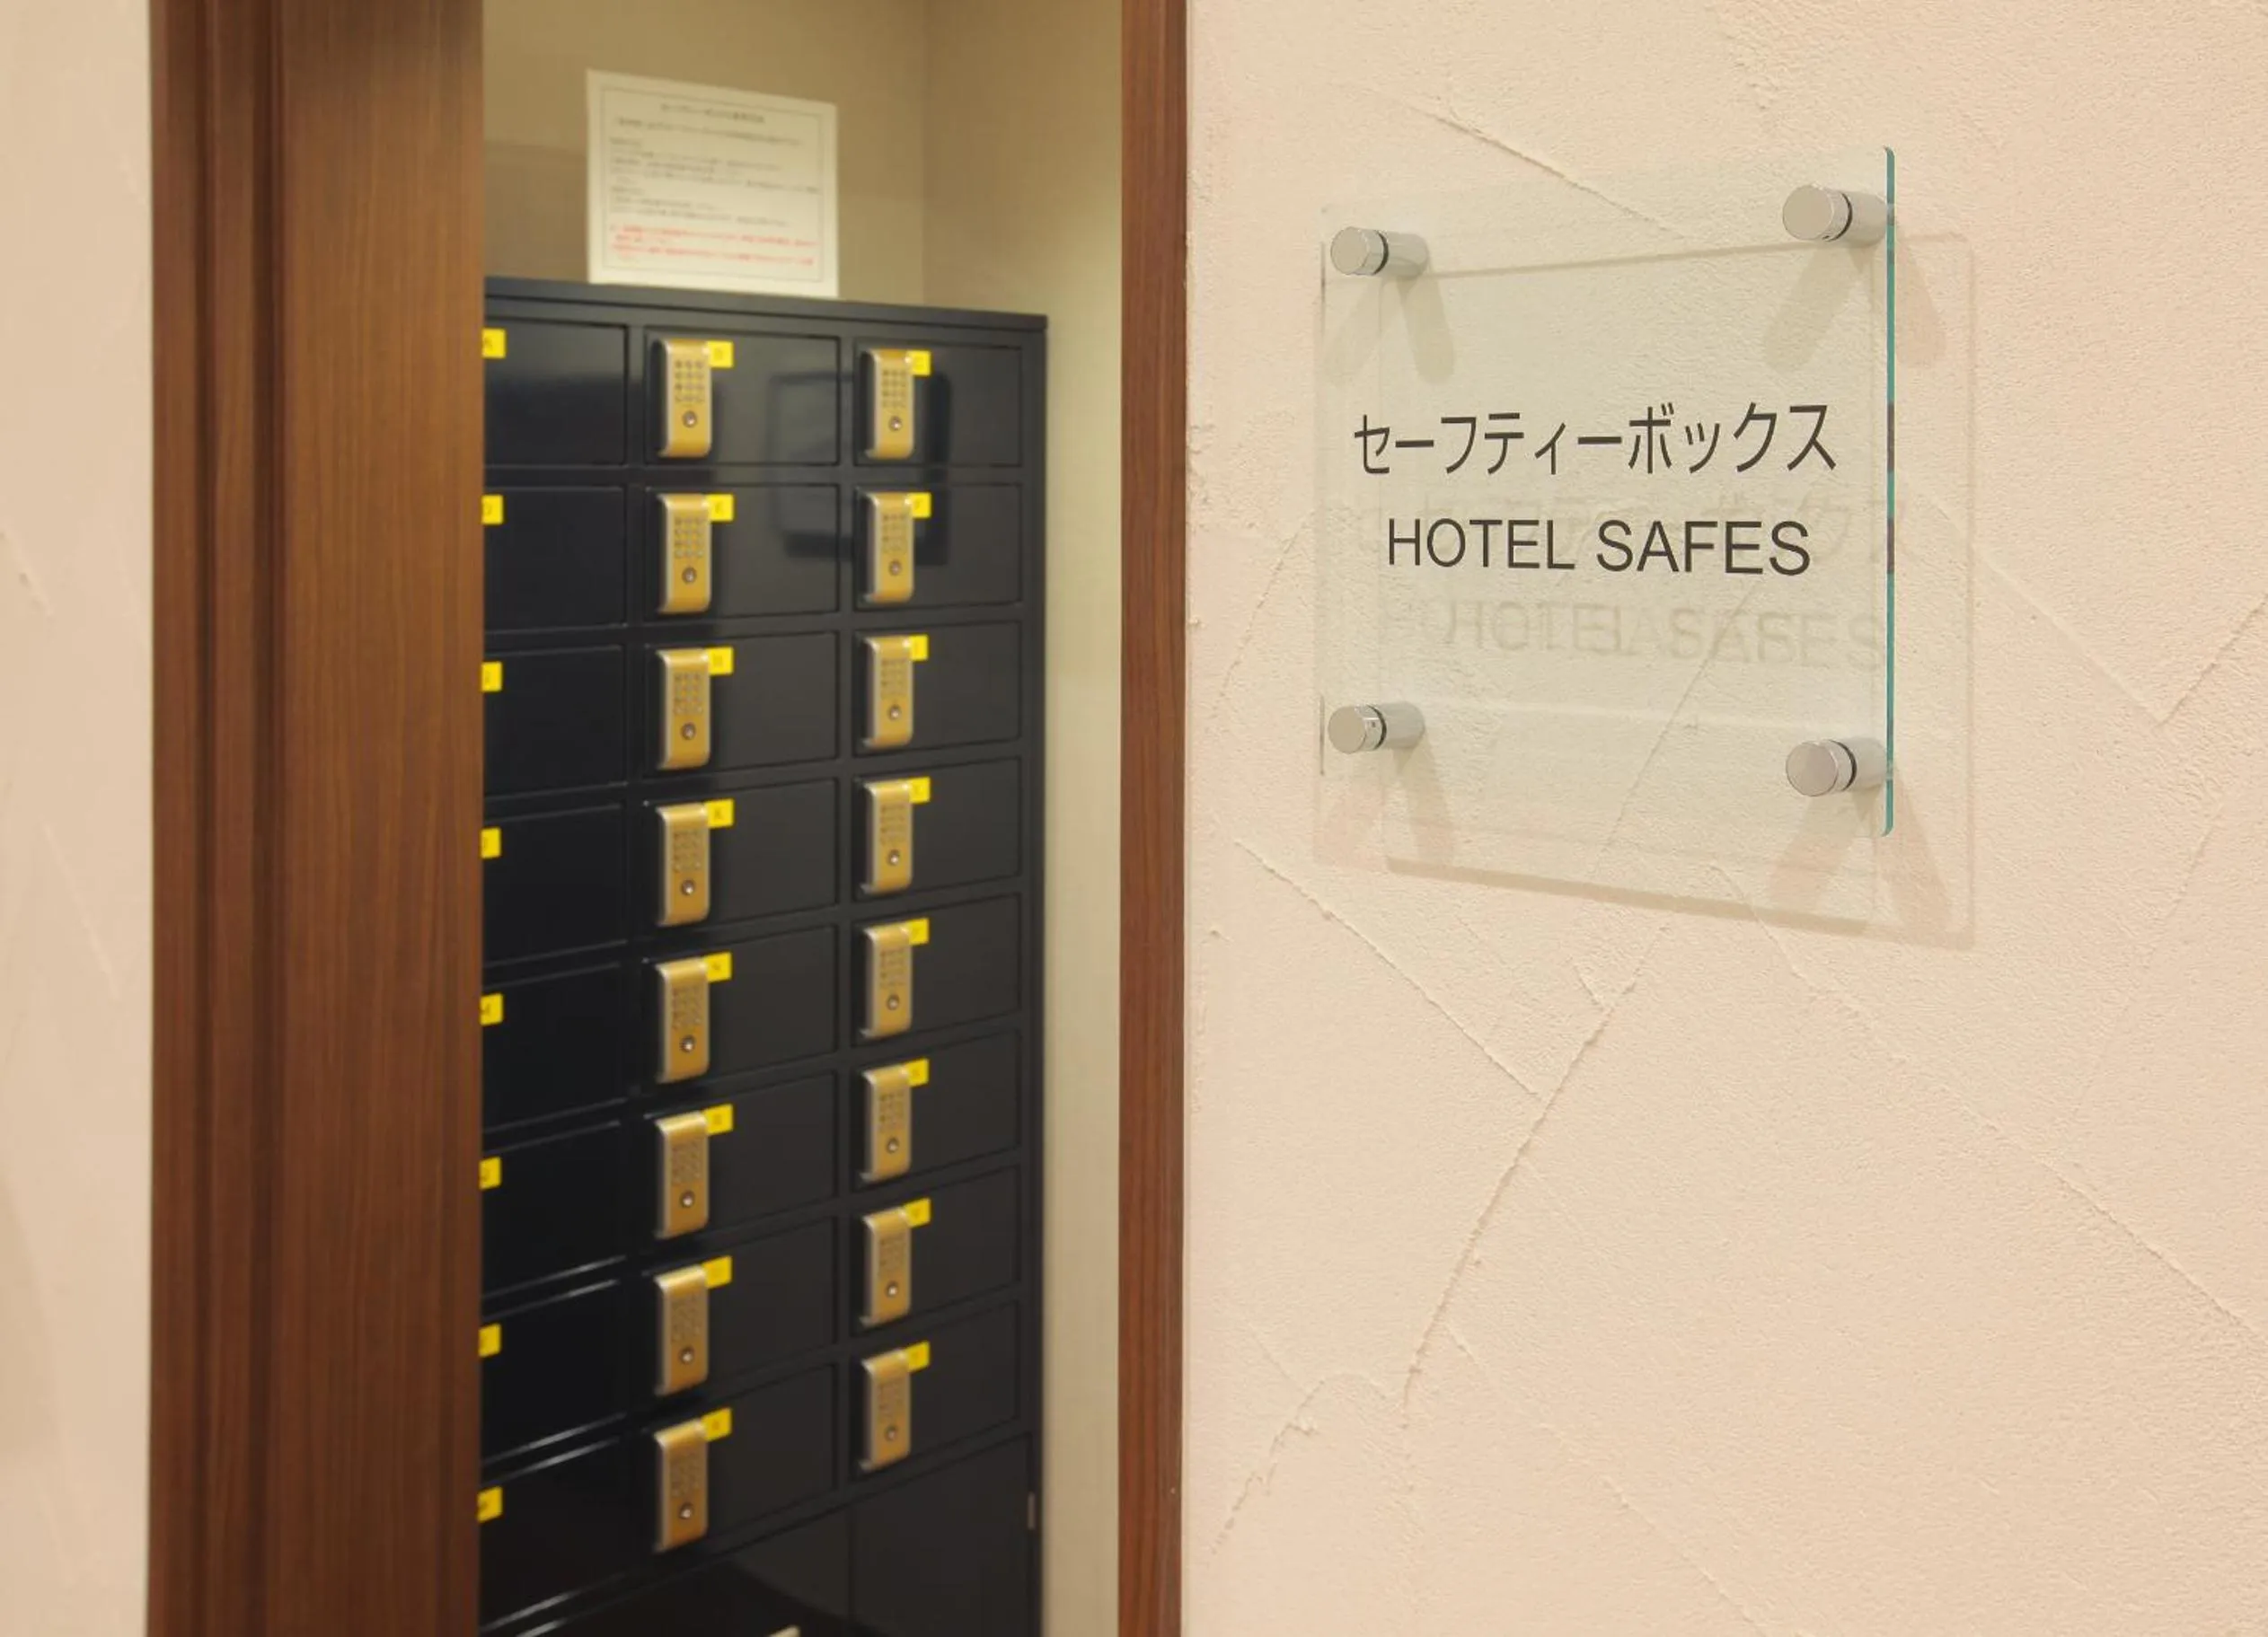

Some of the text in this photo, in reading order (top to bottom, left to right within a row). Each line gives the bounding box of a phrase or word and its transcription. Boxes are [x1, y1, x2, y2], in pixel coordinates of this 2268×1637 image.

[1354, 401, 1837, 475] セーフティーボックス
[1389, 518, 1811, 576] HOTEL SAFES
